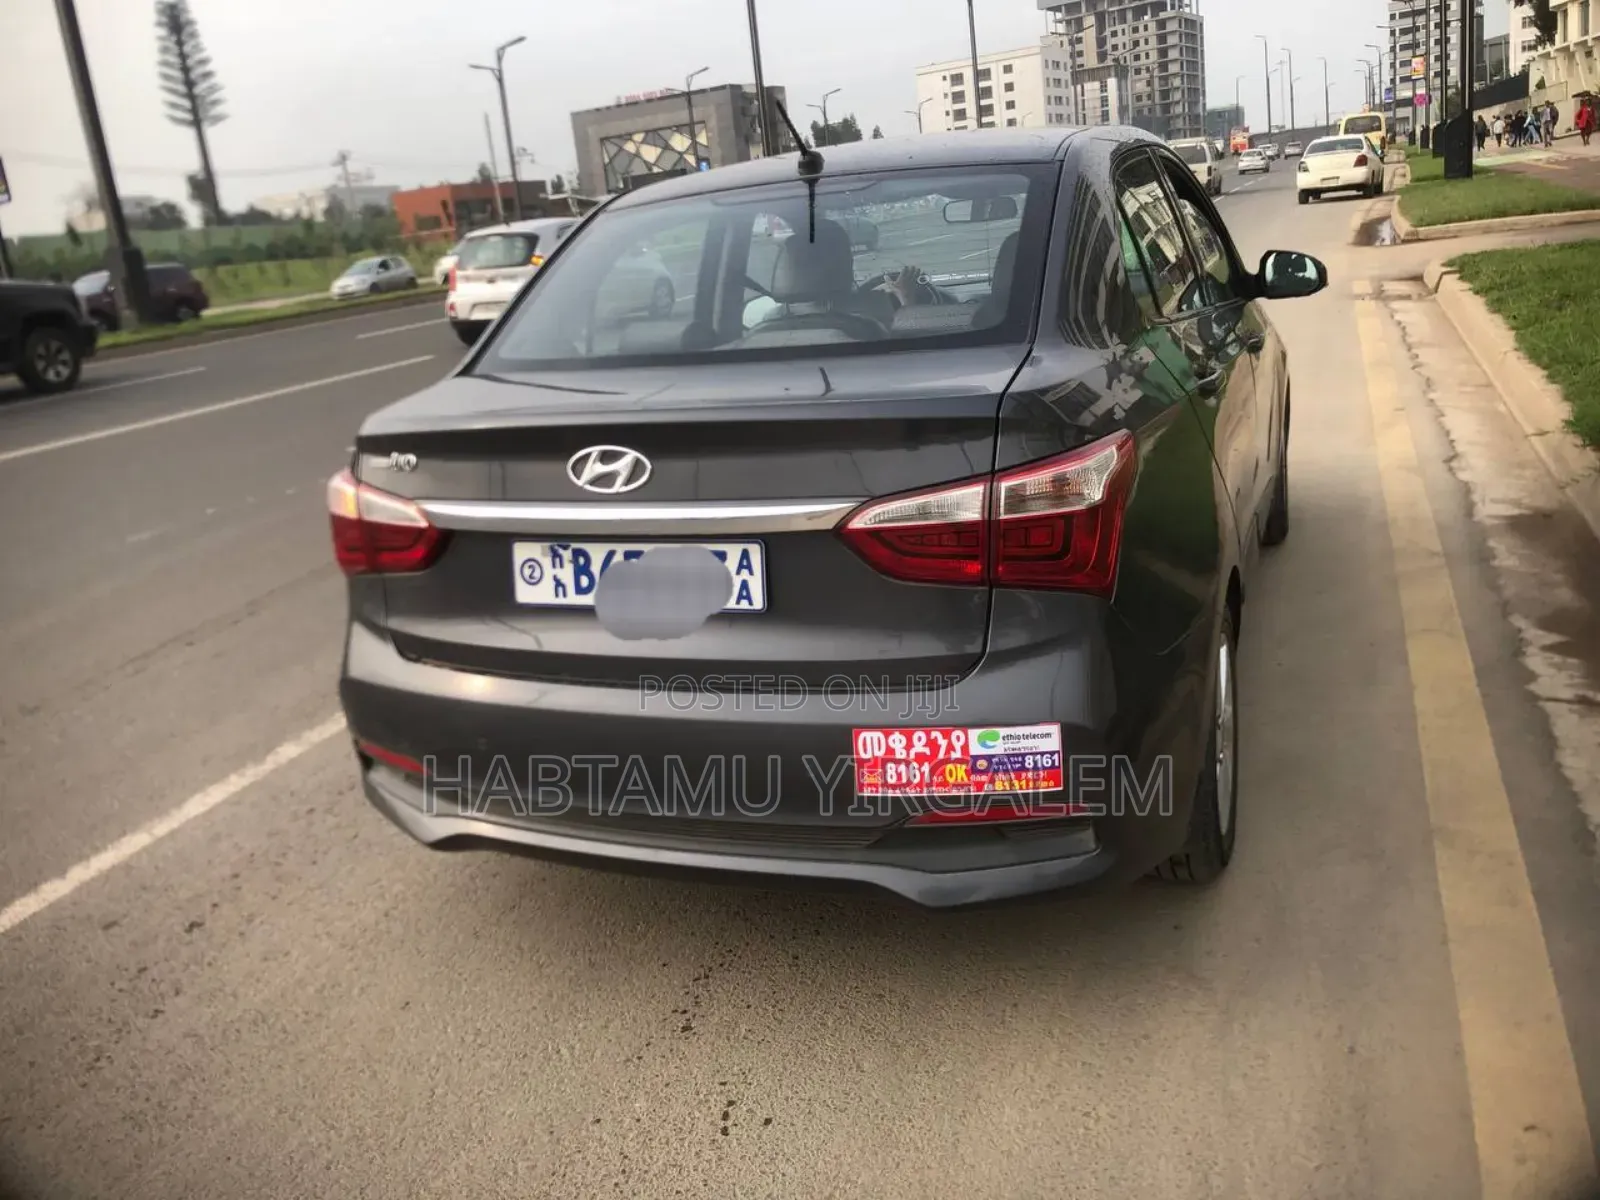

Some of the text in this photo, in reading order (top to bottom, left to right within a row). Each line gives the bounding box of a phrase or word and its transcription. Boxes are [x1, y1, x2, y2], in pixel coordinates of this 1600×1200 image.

[1002, 731, 1052, 741] ethio telecom
[1024, 753, 1059, 768] 8161
[886, 761, 930, 785] 8161
[945, 763, 969, 784] OK
